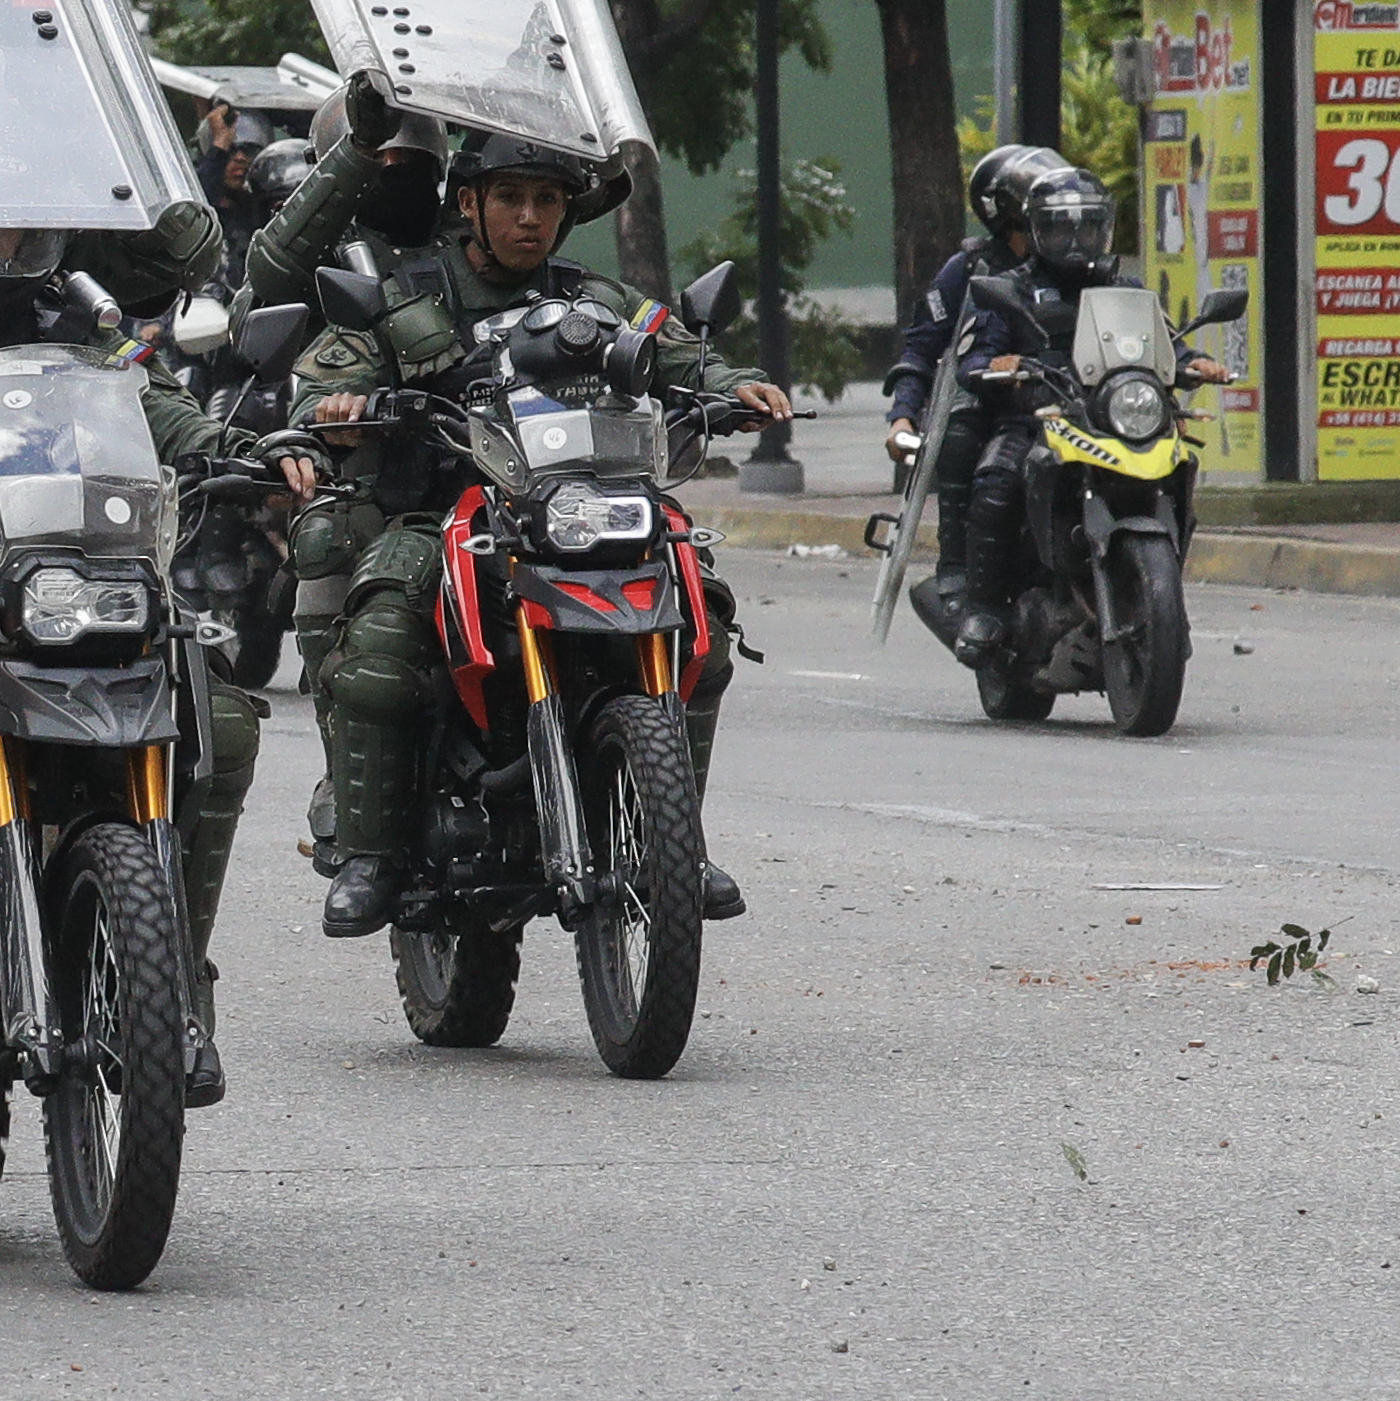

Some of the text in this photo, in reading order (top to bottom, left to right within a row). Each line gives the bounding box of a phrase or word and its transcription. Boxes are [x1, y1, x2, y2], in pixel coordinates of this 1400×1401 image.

[1356, 48, 1376, 68] TE
[1327, 77, 1356, 100] LA
[1317, 274, 1383, 291] ESCANEA
[1321, 292, 1333, 308] Y
[1335, 292, 1381, 308] JUEGA
[1325, 340, 1393, 357] RECARGA
